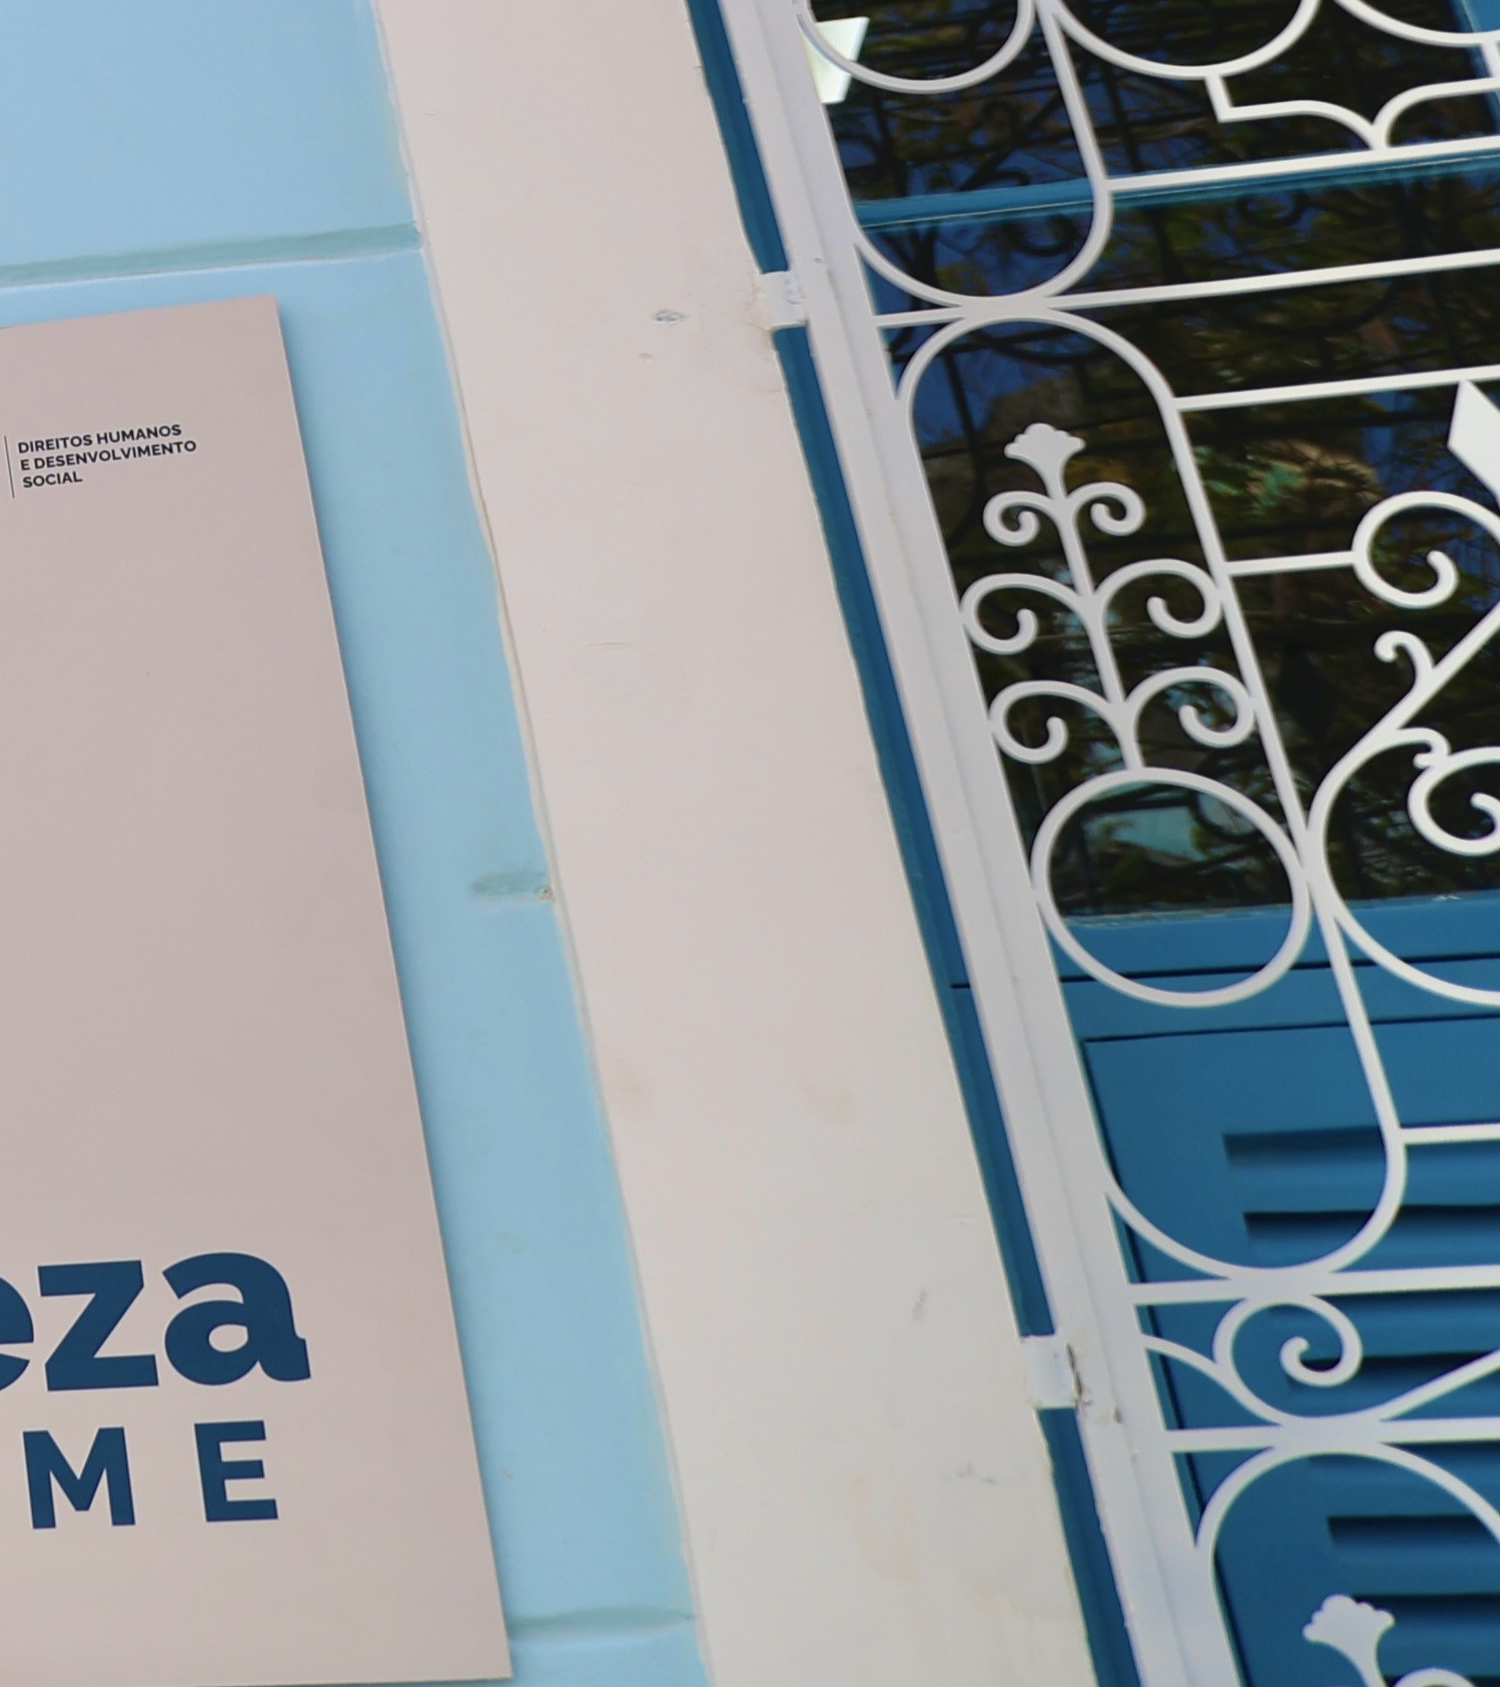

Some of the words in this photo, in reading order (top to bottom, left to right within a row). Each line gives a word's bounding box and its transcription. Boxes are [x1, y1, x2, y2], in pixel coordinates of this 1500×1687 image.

[17, 434, 93, 454] DIREITOS
[96, 423, 182, 445] HUMANOS
[20, 459, 31, 471] E
[34, 440, 197, 470] DESENVOLVIMENTO
[22, 471, 83, 489] SOCIAL
